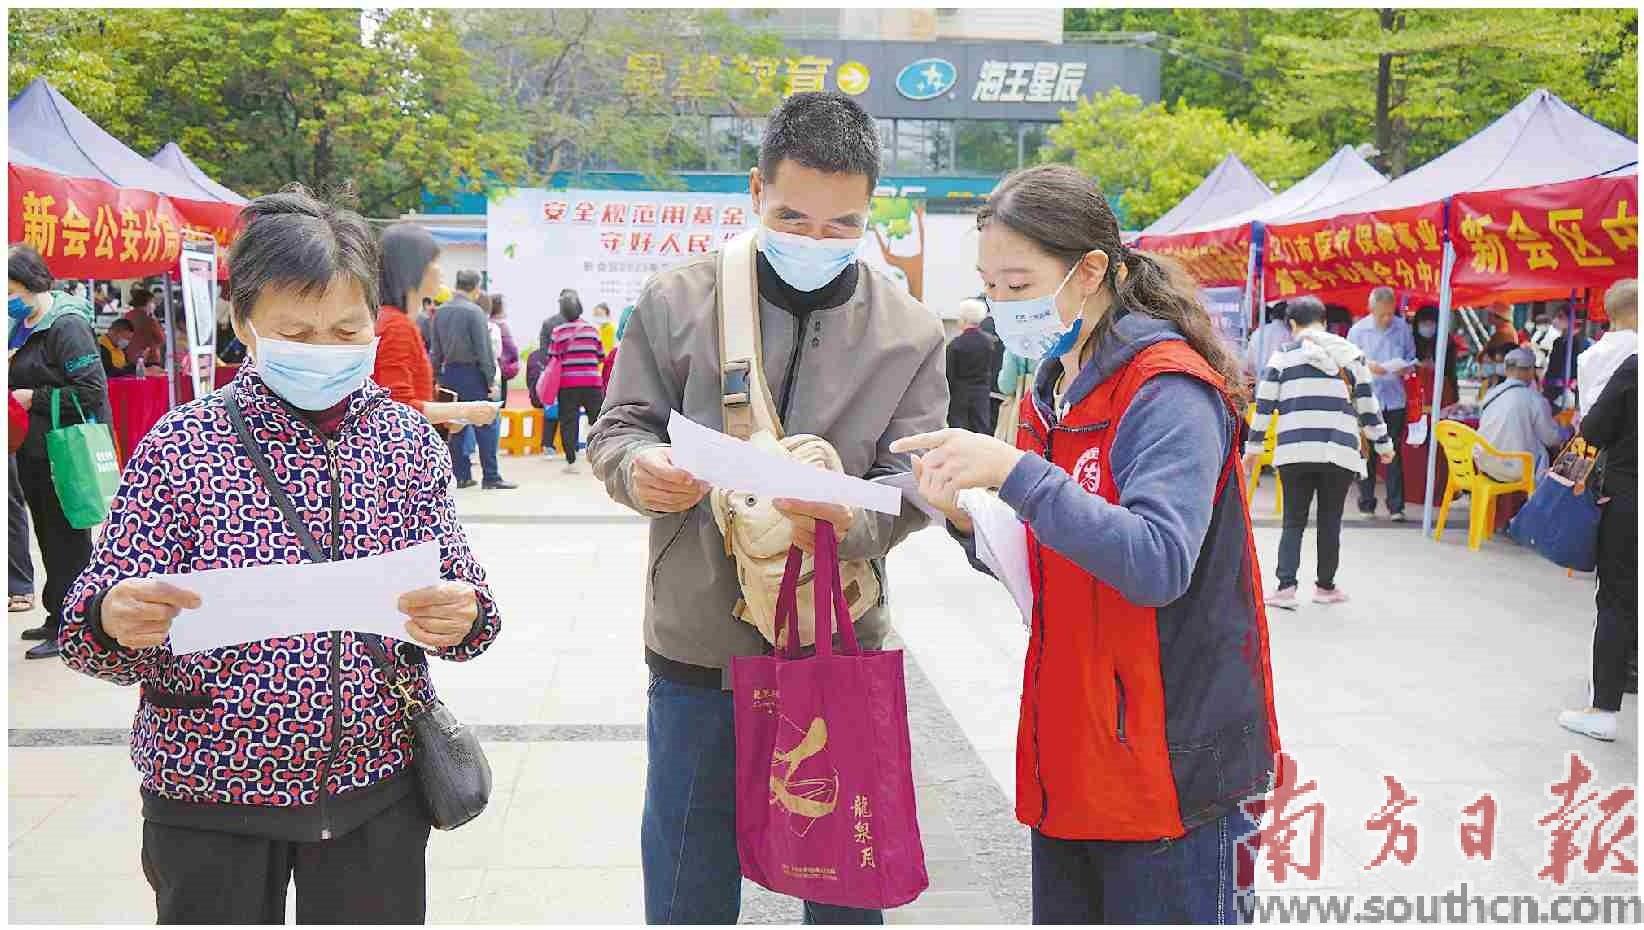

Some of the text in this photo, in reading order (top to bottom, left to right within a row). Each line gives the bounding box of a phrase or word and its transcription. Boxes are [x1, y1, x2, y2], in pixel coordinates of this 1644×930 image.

[971, 59, 1087, 102] 海王星辰
[21, 190, 180, 263] 新会公安分局
[543, 200, 747, 226] 安全规范用基金
[1460, 199, 1638, 273] 新会区中
